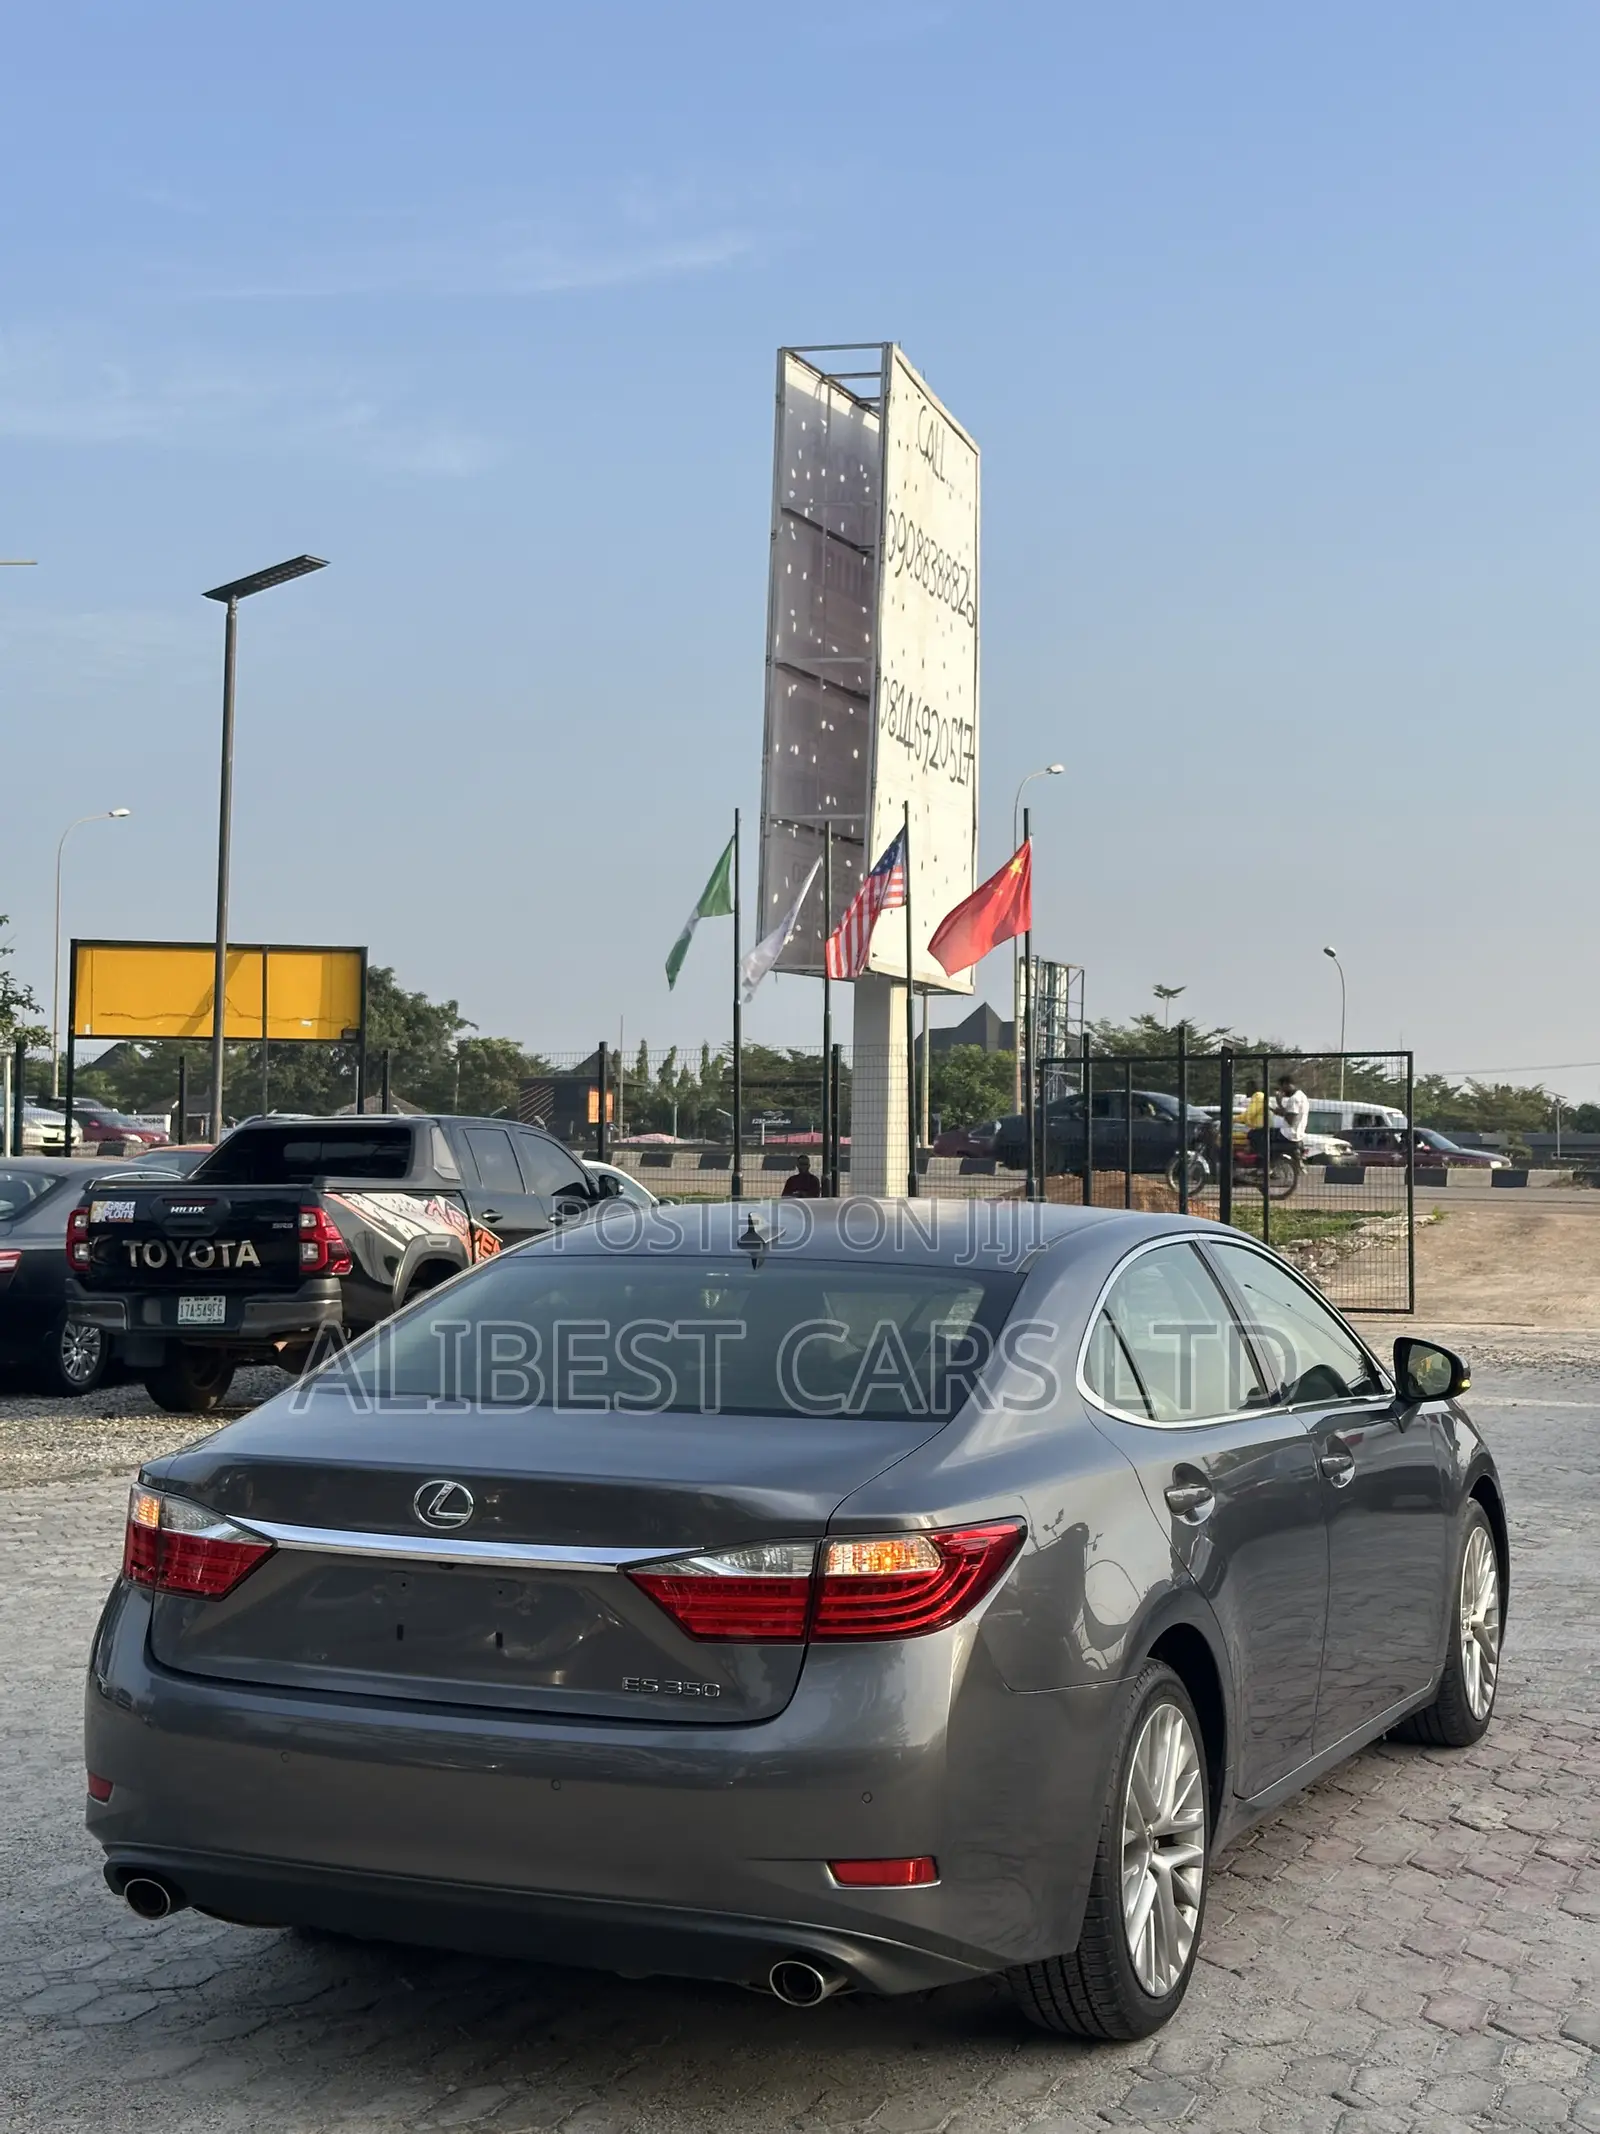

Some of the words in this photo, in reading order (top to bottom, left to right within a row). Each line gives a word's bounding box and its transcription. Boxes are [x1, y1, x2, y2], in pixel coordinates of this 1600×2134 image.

[122, 1239, 261, 1269] TOYOTA
[622, 1677, 659, 1692] ES
[664, 1681, 720, 1697] 350
